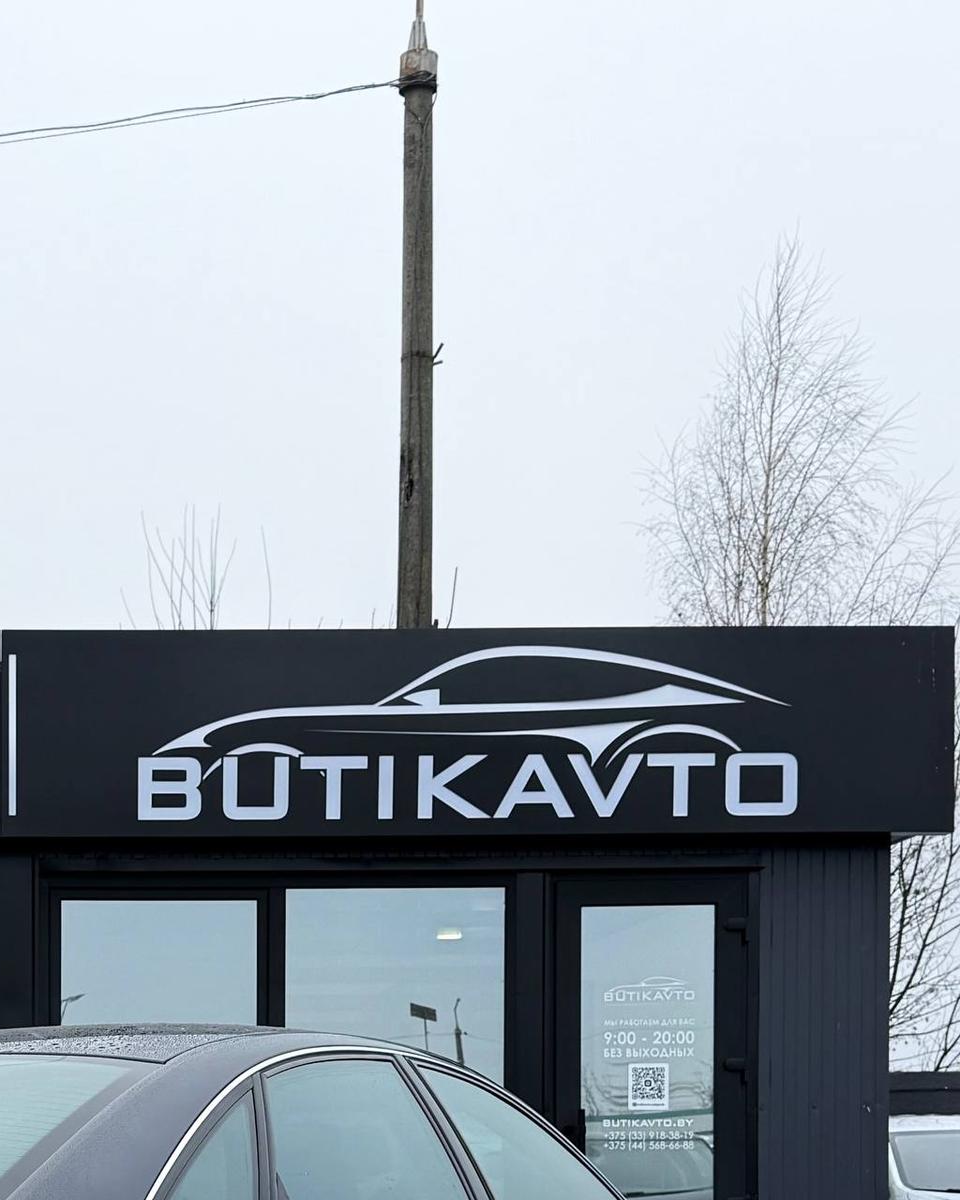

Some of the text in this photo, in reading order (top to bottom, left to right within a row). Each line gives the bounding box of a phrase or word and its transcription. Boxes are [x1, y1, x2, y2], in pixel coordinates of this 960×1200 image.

[137, 752, 798, 821] BUTIKAVTO
[603, 990, 695, 1002] BUTIKAVTO
[603, 1031, 636, 1045] 9:00
[652, 1030, 695, 1045] 20:00
[603, 1047, 695, 1058] БЕЗ ВЫХОДНЫХ
[602, 1118, 695, 1128] BUTIKAVTO.BY
[604, 1130, 695, 1142] +375 (33) 918-38-19
[604, 1140, 695, 1152] +375 (44) 568-66-88
